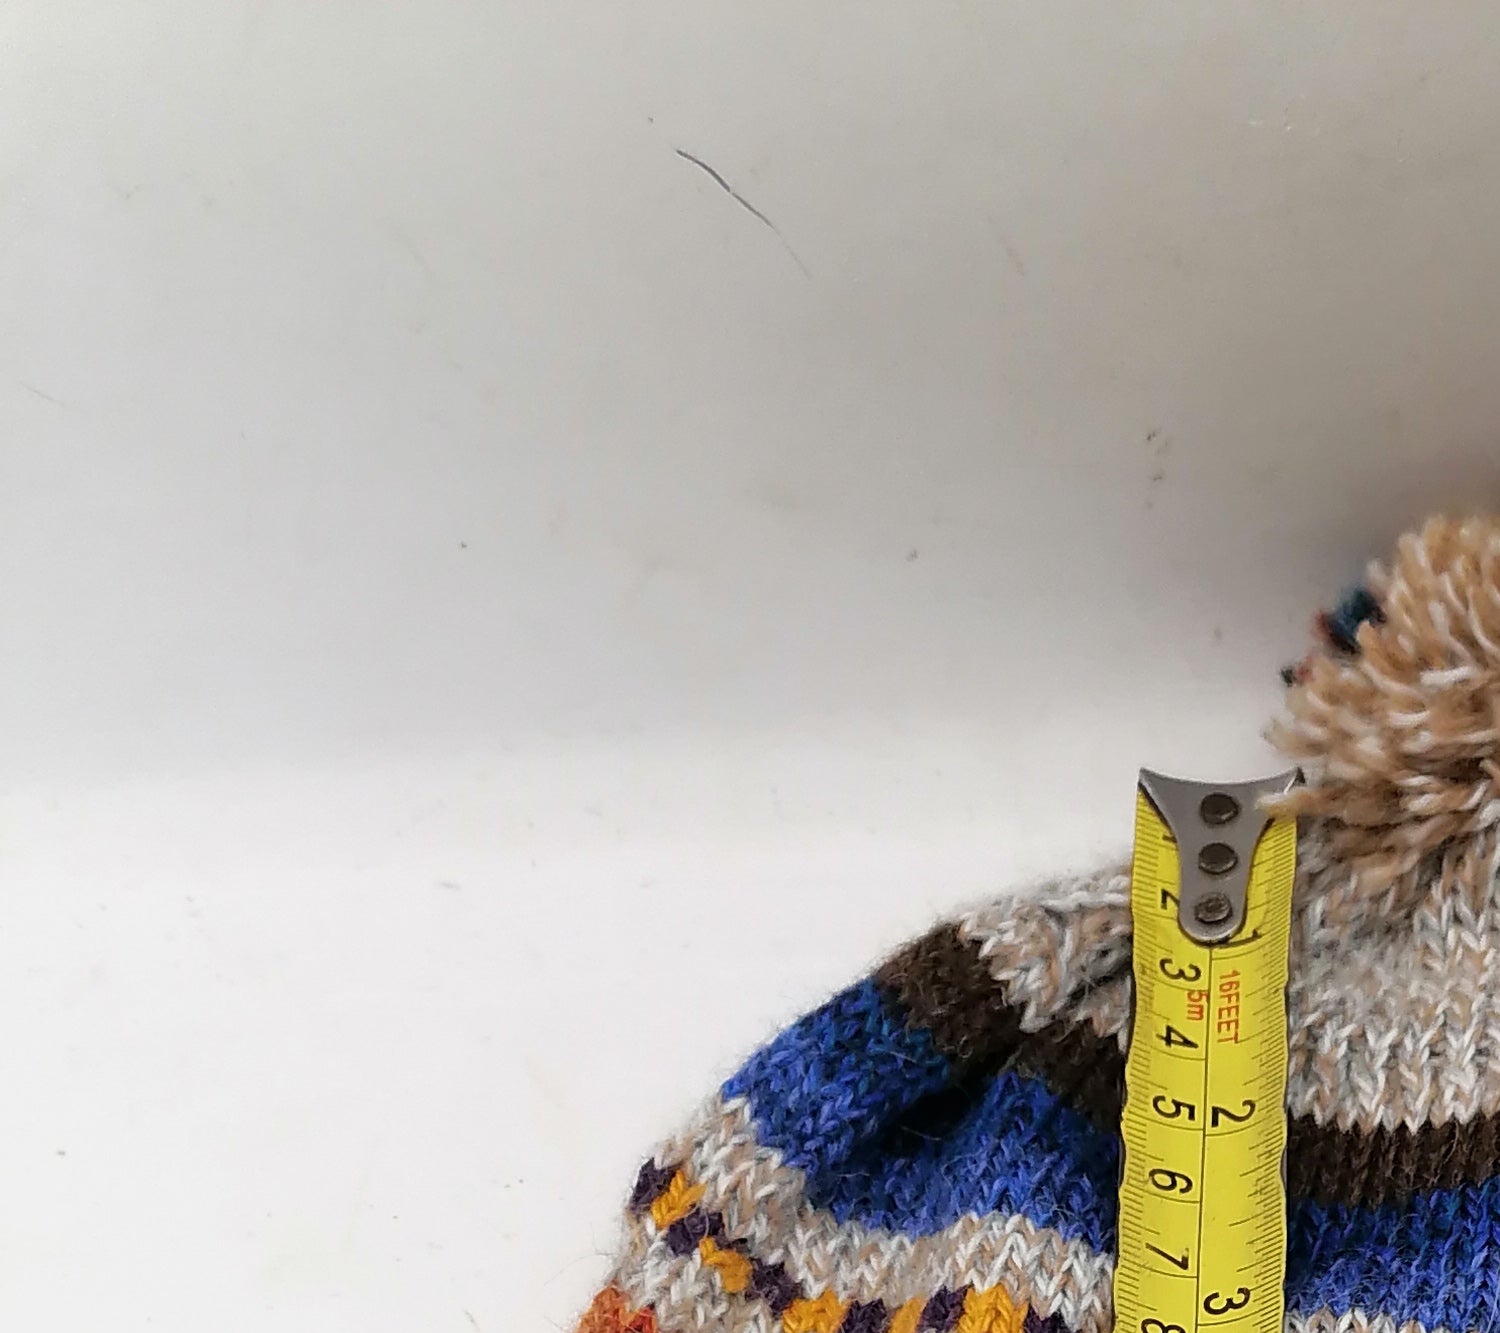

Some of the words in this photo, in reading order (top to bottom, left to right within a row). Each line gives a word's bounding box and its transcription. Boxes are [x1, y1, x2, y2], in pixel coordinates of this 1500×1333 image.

[1159, 958, 1202, 983] 3
[1217, 969, 1241, 1045] 16FEET
[1156, 1025, 1199, 1049] 4
[1152, 1095, 1196, 1121] 5
[1211, 1100, 1256, 1128] 2
[1149, 1168, 1193, 1194] 6
[1145, 1242, 1190, 1271] 7
[1203, 1287, 1251, 1315] 3
